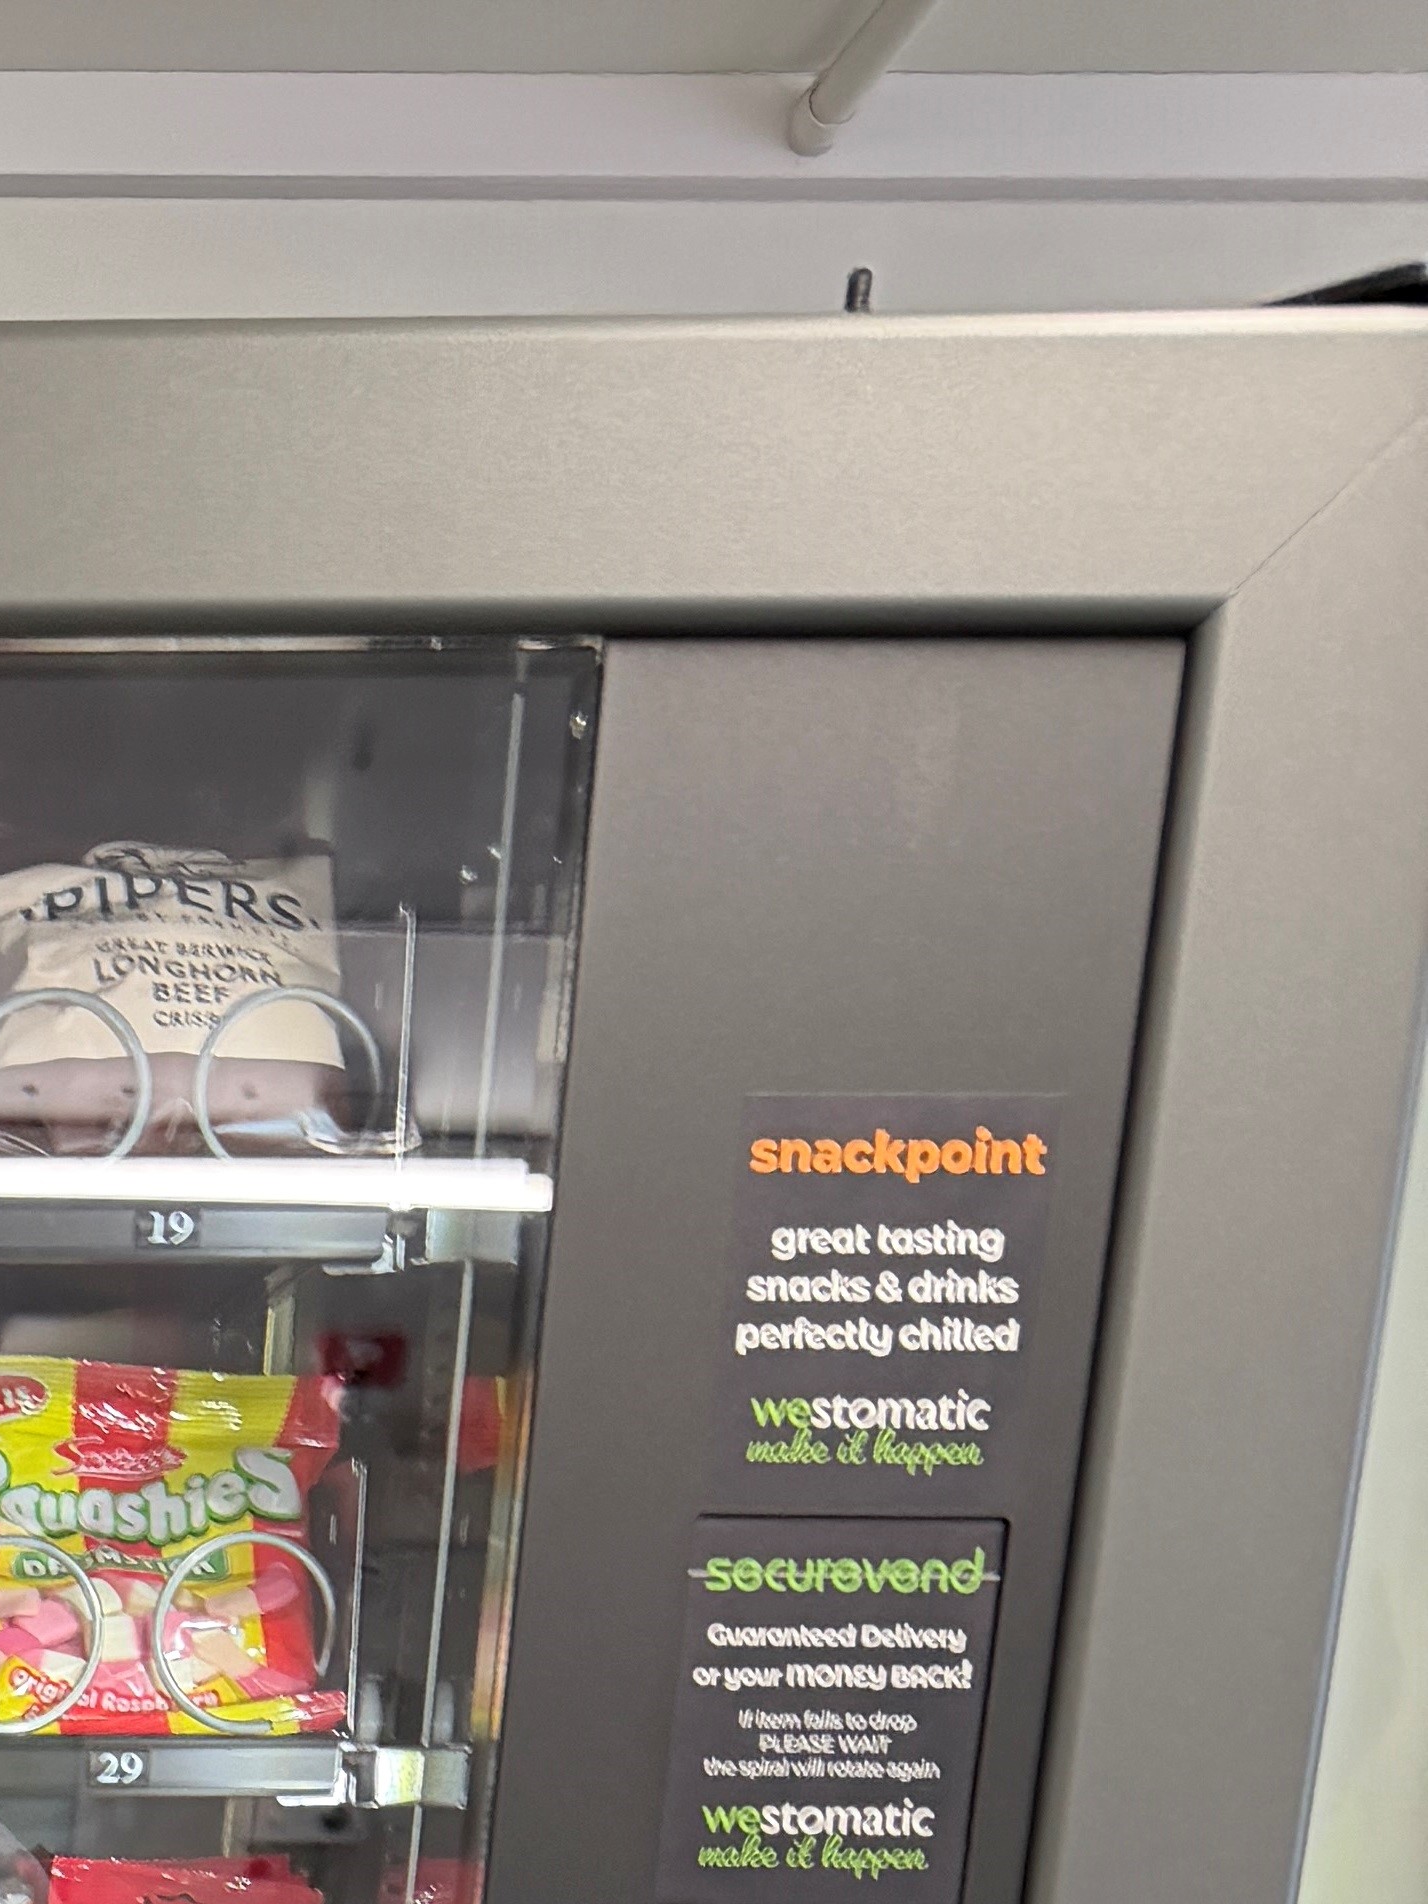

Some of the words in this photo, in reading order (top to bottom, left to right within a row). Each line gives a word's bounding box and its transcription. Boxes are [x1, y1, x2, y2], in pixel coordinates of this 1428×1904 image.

[151, 982, 231, 1005] BEEF
[749, 1126, 1048, 1184] snackpoint
[147, 1211, 197, 1247] 19
[771, 1223, 872, 1262] great
[876, 1219, 1005, 1263] tasting
[746, 1269, 872, 1303] snacks
[875, 1270, 903, 1303] &
[907, 1268, 1020, 1303] drinks
[735, 1316, 893, 1357] perfectly
[898, 1316, 1021, 1352] chilled
[750, 1387, 992, 1431] westomatic
[745, 1427, 831, 1465] make
[836, 1431, 870, 1465] it
[872, 1429, 985, 1477] happen
[704, 1546, 985, 1595] securevend
[707, 1622, 858, 1649] Guaranteed
[860, 1623, 967, 1654] Delivery
[692, 1666, 721, 1687] or
[723, 1666, 783, 1692] your
[803, 1709, 844, 1731] fails
[845, 1711, 868, 1731] to
[869, 1709, 918, 1734] drop
[758, 1734, 836, 1755] PLEASE
[837, 1734, 893, 1755] WAIT
[95, 1752, 144, 1785] 29
[703, 1756, 738, 1777] the
[738, 1758, 790, 1780] spiral
[791, 1758, 826, 1779] will
[827, 1759, 885, 1780] rotate
[886, 1758, 941, 1783] again
[701, 1797, 936, 1838] westomatic
[697, 1834, 780, 1869] make
[785, 1835, 817, 1870] it
[821, 1833, 930, 1881] happen
